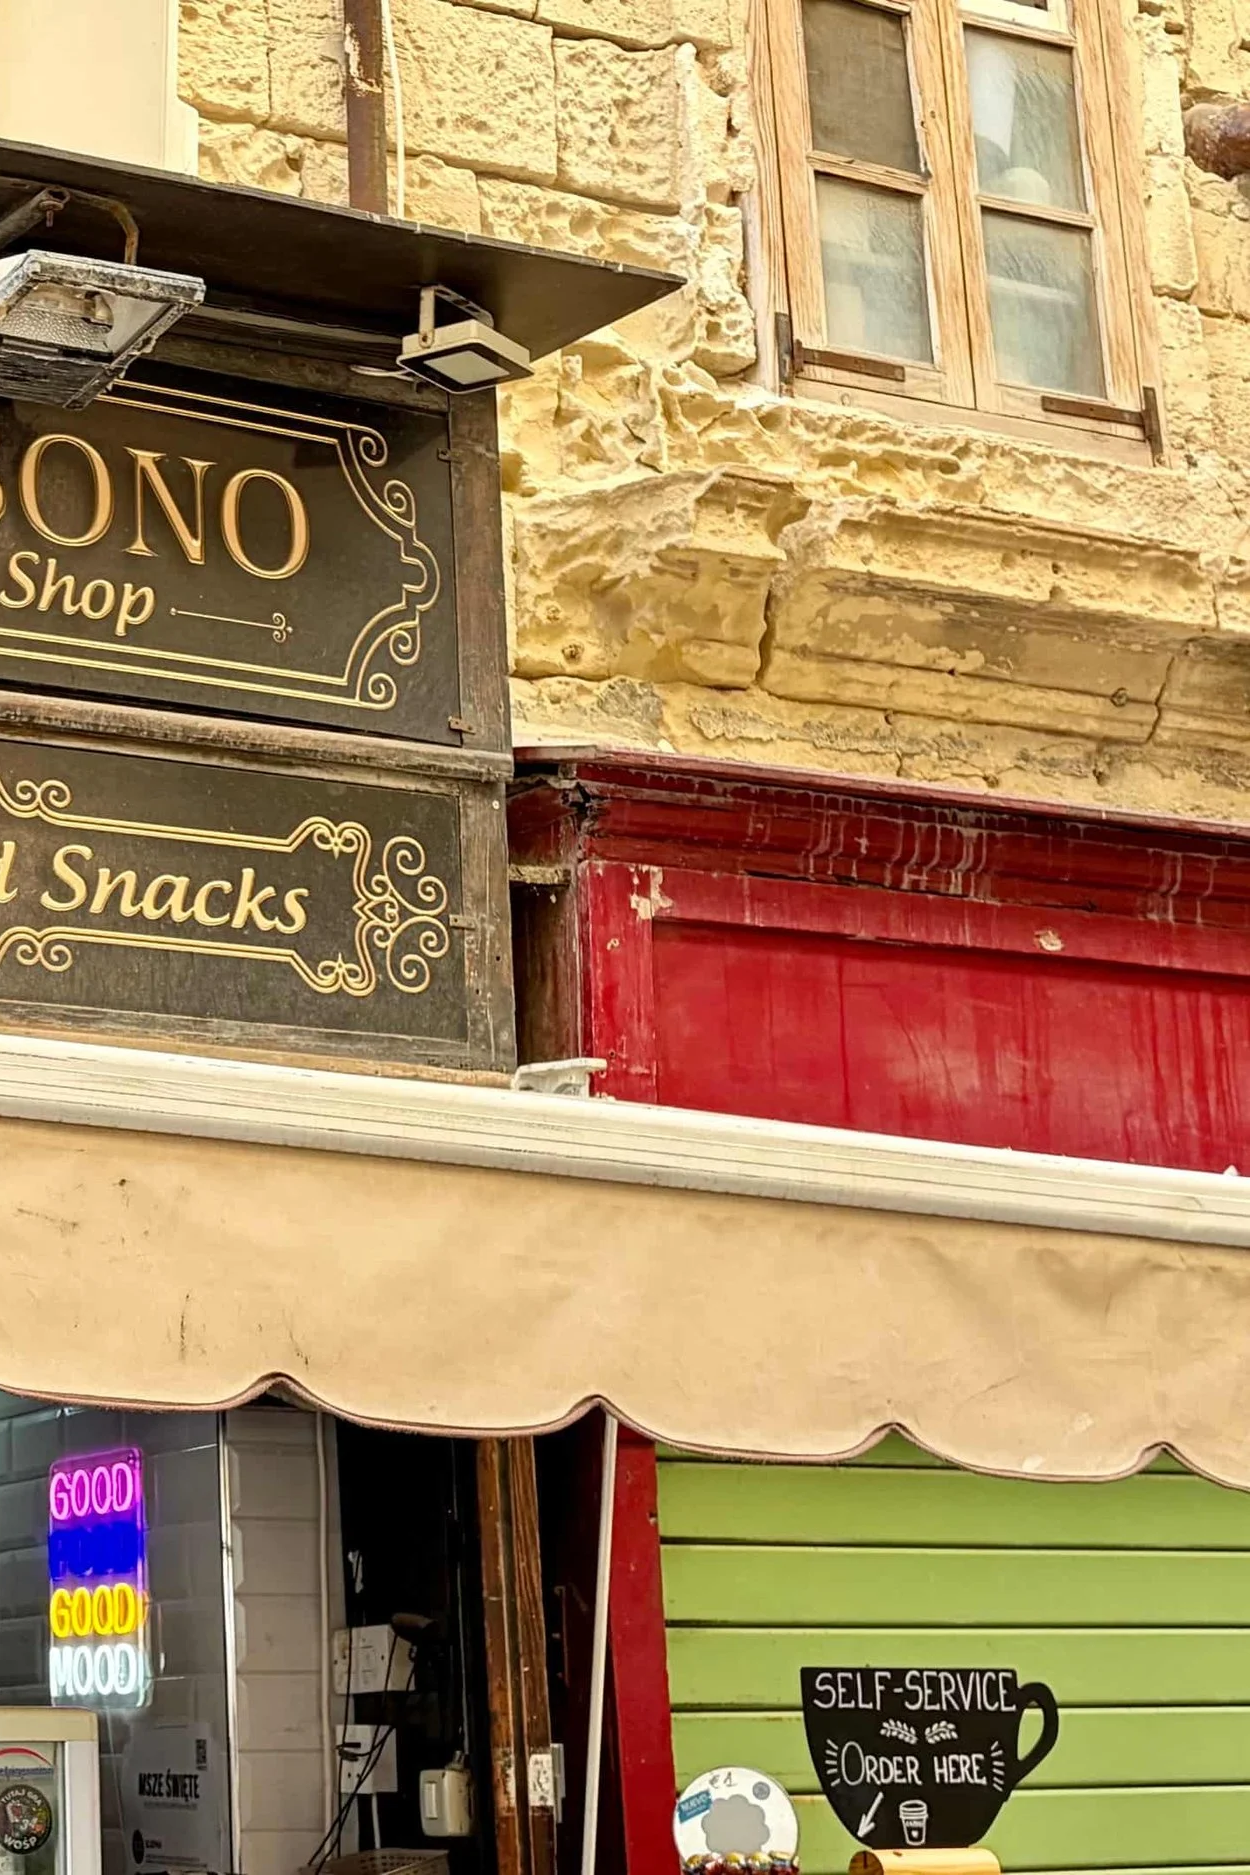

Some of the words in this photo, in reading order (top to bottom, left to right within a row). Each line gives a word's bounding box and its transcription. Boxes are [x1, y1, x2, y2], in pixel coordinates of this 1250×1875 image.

[0, 550, 157, 638] Shop
[40, 842, 310, 936] Snacks
[49, 1462, 134, 1520] GOOD
[50, 1582, 137, 1637] GOOD
[49, 1643, 138, 1697] MOOD
[813, 1668, 1018, 1712] SELF-SERVICE
[138, 1772, 164, 1797] MSZE
[165, 1768, 200, 1803] ŚWIĘTE
[840, 1740, 923, 1787] ORDER
[933, 1752, 988, 1786] HERE
[1, 1788, 26, 1804] TUTAJ
[3, 1833, 38, 1850] WOŚP
